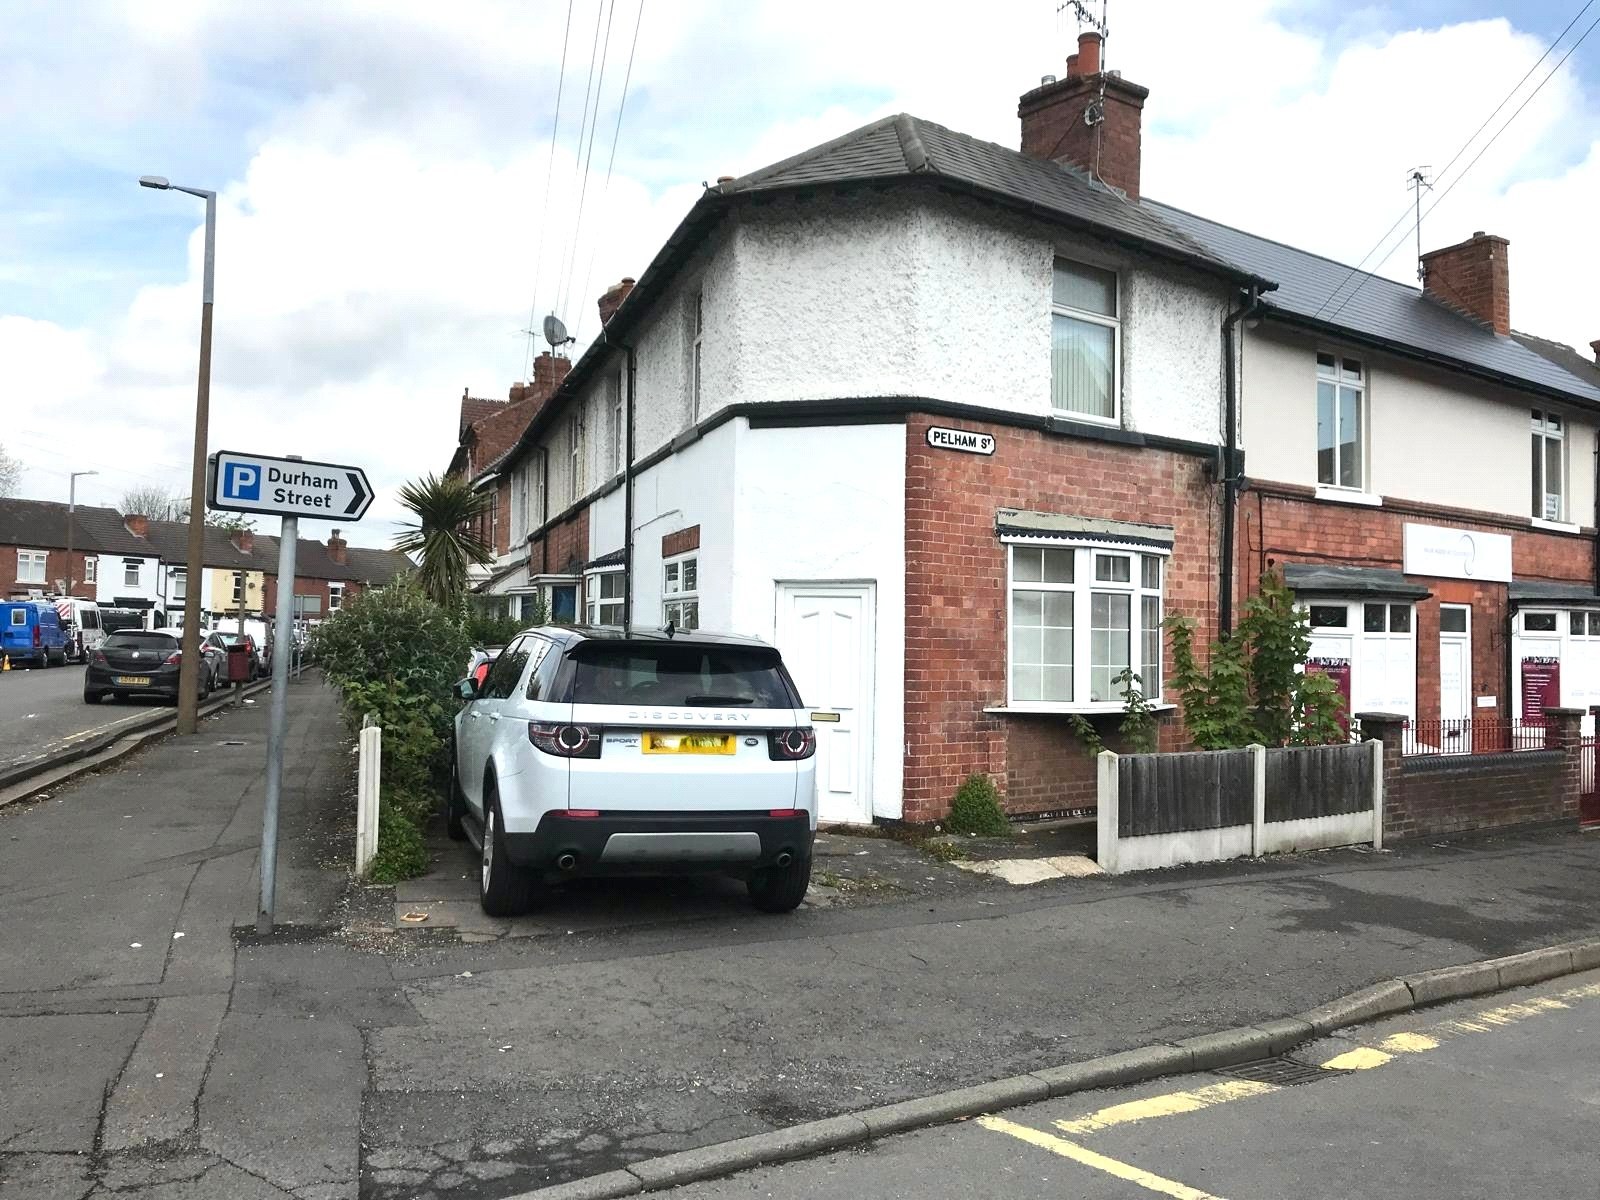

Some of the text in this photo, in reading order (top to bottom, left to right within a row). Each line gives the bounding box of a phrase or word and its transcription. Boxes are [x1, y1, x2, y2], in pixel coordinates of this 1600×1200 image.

[933, 431, 977, 448] PELHAM
[231, 466, 257, 497] P
[268, 467, 338, 490] Durham
[273, 488, 332, 508] Street
[628, 711, 751, 721] DISCOVERY
